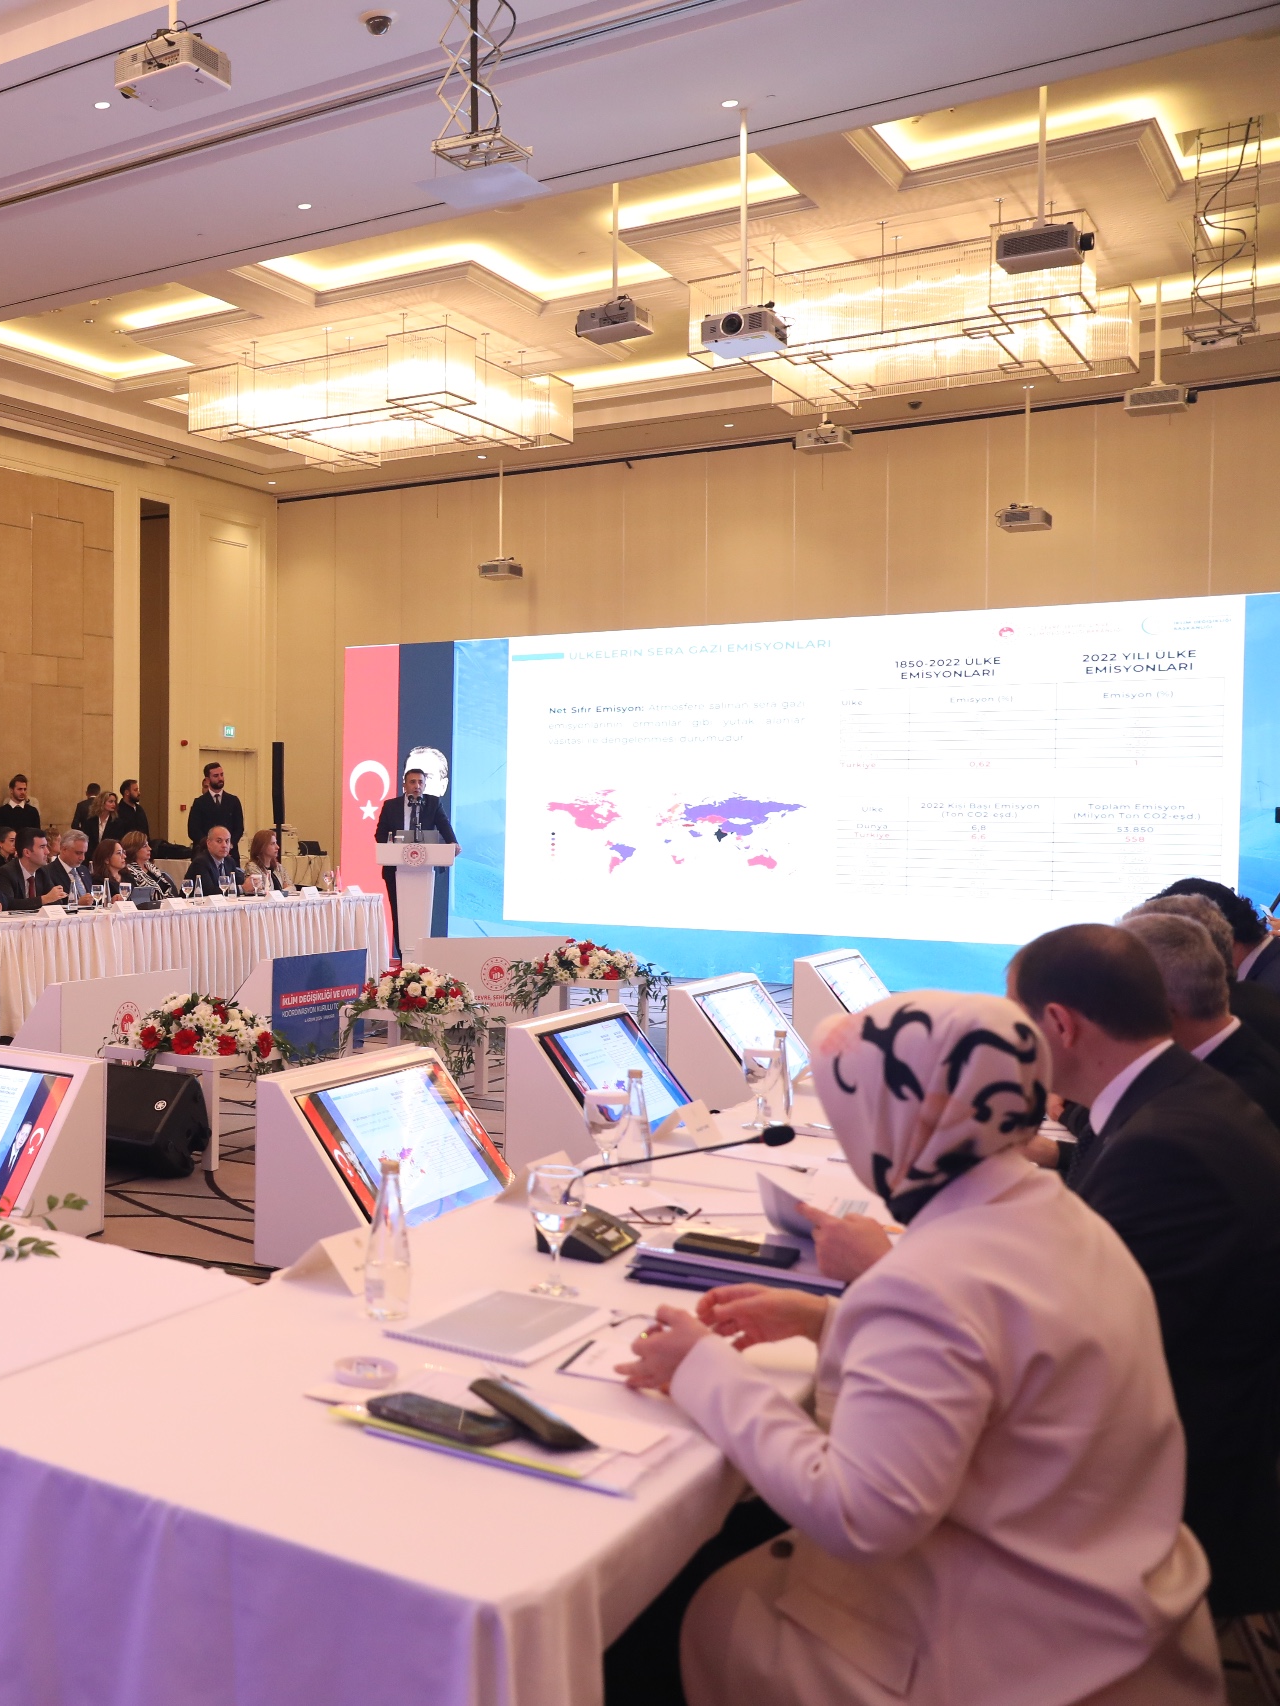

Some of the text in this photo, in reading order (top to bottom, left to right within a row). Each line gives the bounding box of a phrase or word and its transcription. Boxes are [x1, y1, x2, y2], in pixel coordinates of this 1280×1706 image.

[648, 646, 685, 657] SERA
[727, 638, 832, 653] EMİSYONLARI
[895, 654, 1002, 669] 1850-2022 ÜLKE
[1082, 649, 1197, 663] 2022 YILI ÜLKE
[900, 668, 995, 680] EMİSYONLARI
[1085, 662, 1193, 675] EMİSYONLARI
[1103, 690, 1152, 700] Emisyon
[549, 706, 567, 715] Net
[595, 703, 645, 716] Emisyon:
[1088, 803, 1186, 812] Toplam Emisyon
[282, 988, 357, 1006] İKLİM DEĞİŞİKLİĞİ VE UYUM
